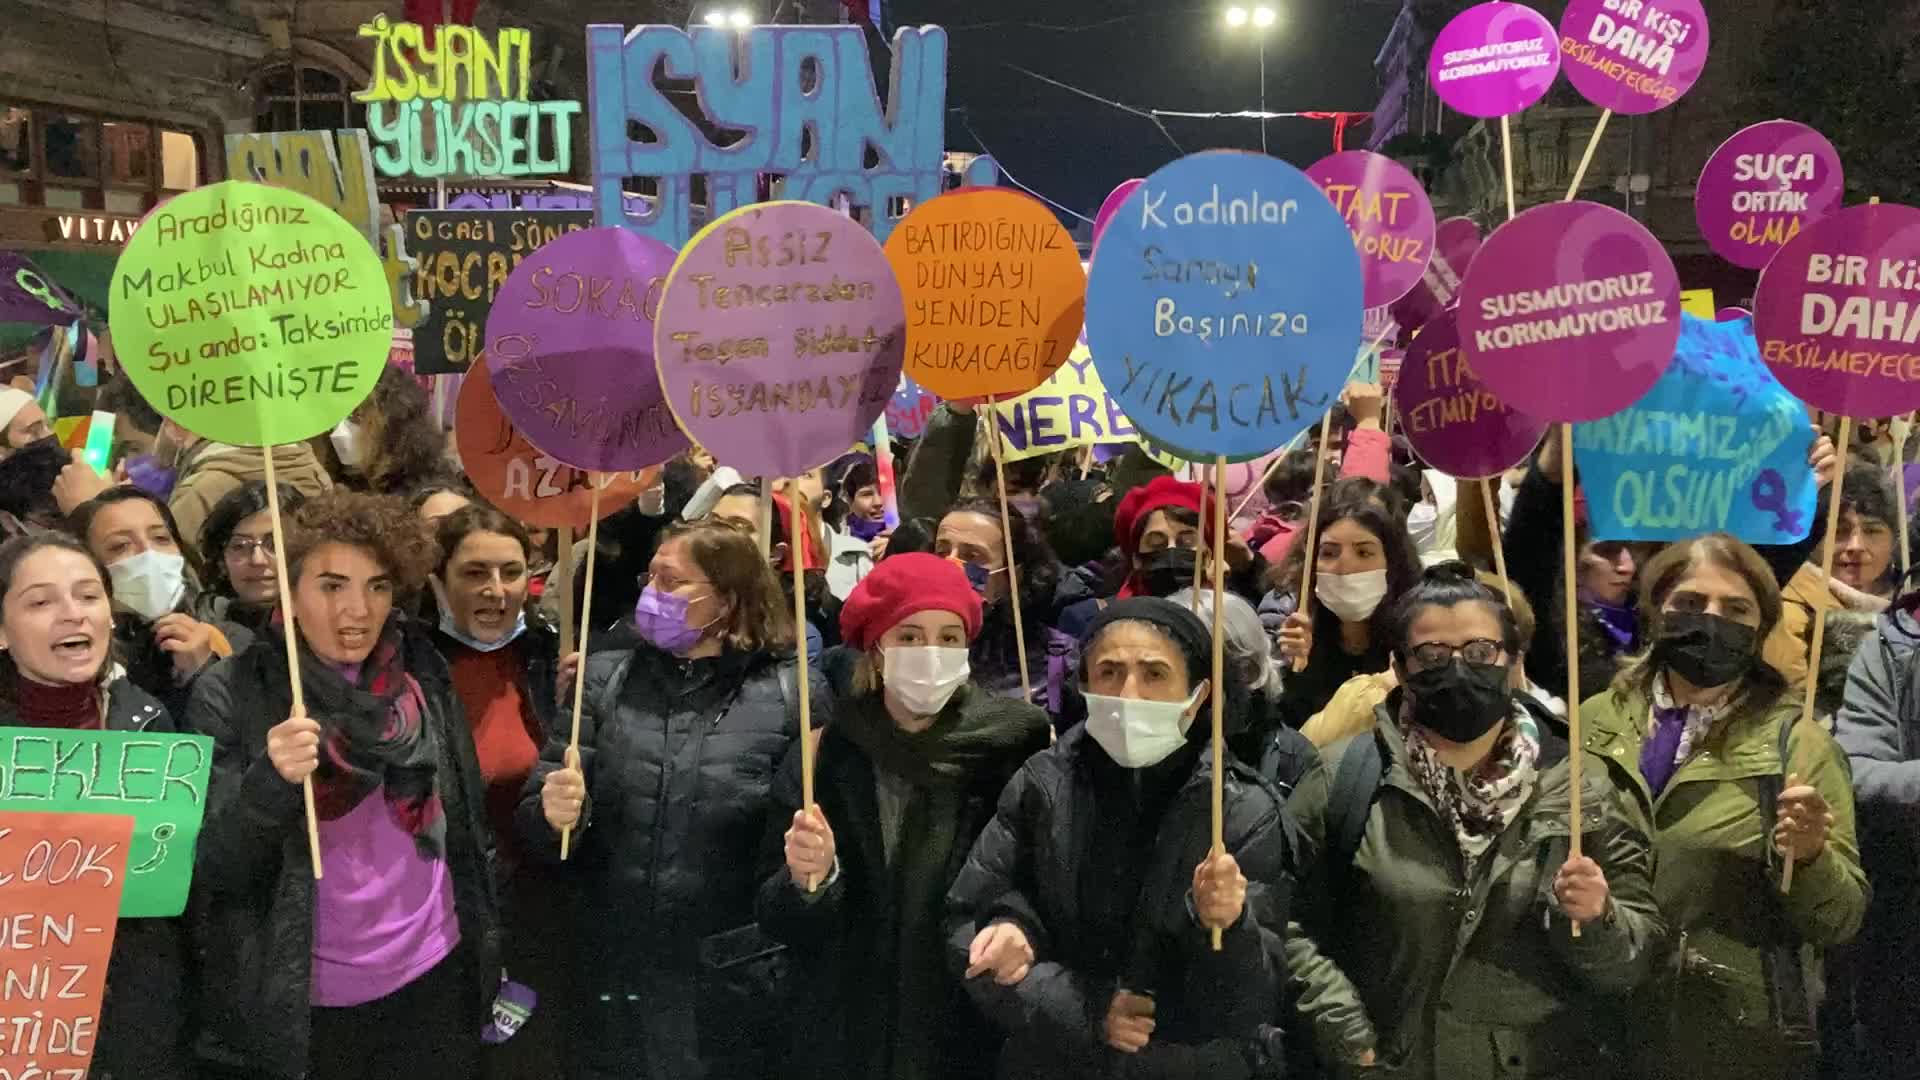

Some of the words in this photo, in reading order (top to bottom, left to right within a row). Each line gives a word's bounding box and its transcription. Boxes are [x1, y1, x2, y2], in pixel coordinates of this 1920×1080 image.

[1587, 12, 1676, 76] DAHA
[366, 97, 582, 176] YÜKSELT
[1733, 153, 1815, 192] SUÇA
[1140, 184, 1298, 231] Kadınlar
[1731, 191, 1809, 213] ORTAK
[905, 217, 1063, 256] BATIRDIĞINIZ
[122, 250, 237, 300] Makbul
[249, 239, 345, 273] Kadına
[916, 260, 1035, 291] DÜNYAYI
[146, 267, 358, 330] ULAŞILAMIYOR
[912, 293, 1042, 329] YENİDEN
[1154, 297, 1309, 343] Başınıza
[1480, 271, 1656, 321] SUSMUYORUZ
[1474, 300, 1668, 353] KORKMUYORUZ
[912, 336, 1060, 376] KURACAĞIZ
[167, 360, 360, 412] DİRENİŞTE
[1120, 352, 1329, 433] YIKACAK
[1409, 388, 1505, 432] ETMİYO
[1612, 463, 1740, 530] OLSUN
